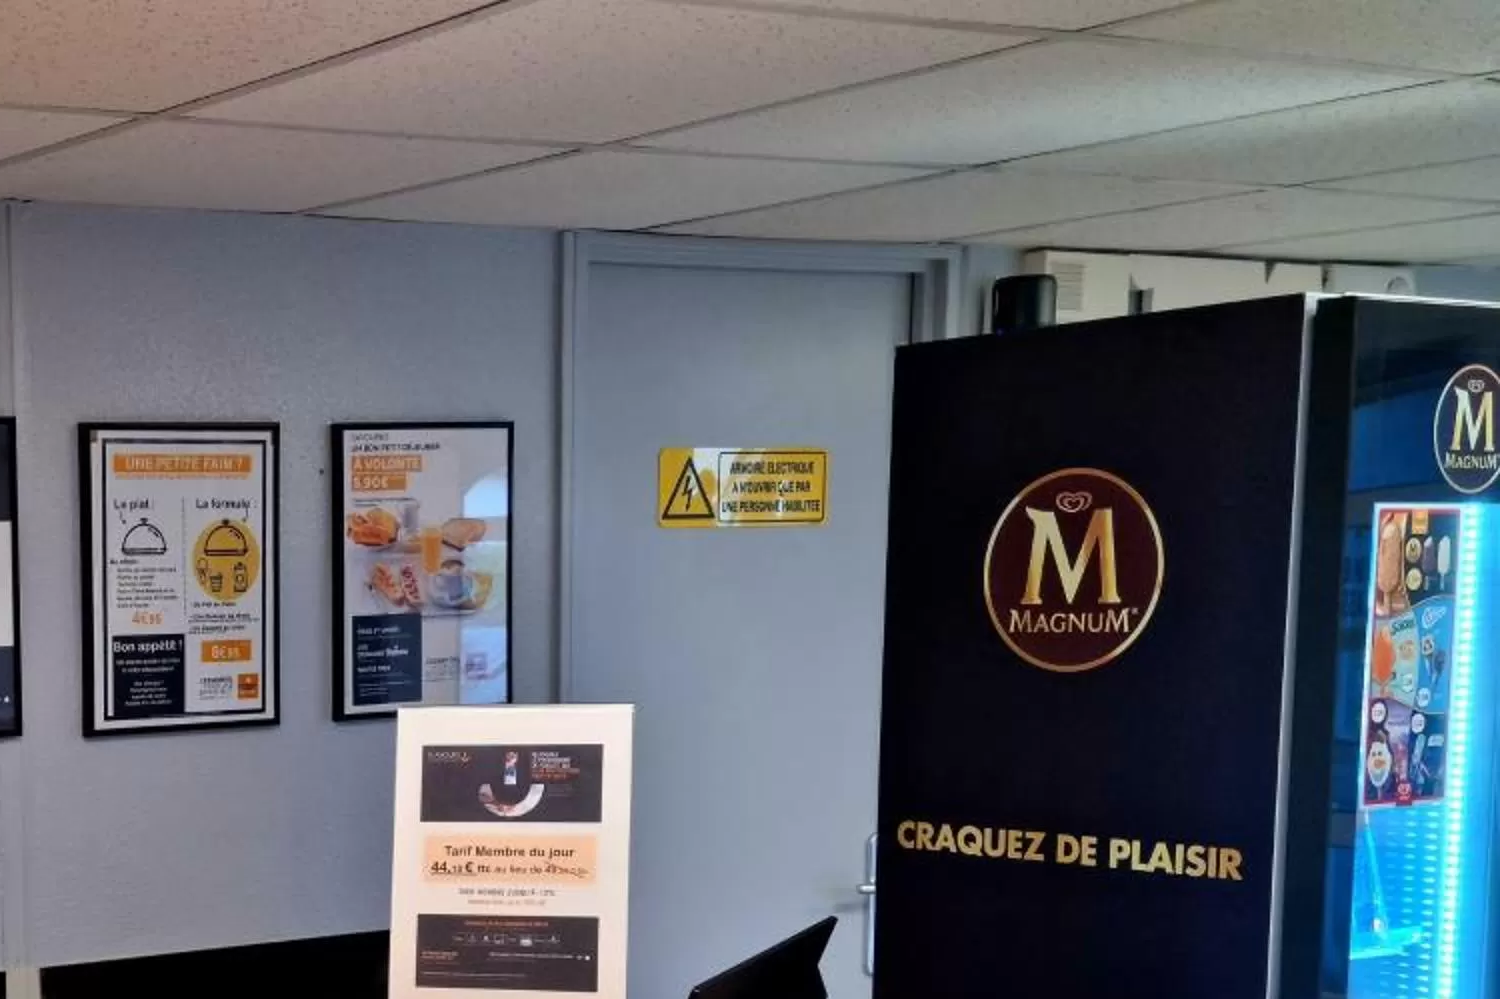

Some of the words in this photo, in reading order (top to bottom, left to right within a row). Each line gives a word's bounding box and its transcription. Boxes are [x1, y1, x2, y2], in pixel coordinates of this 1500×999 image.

[1451, 387, 1495, 451] M
[1445, 453, 1497, 471] MAGNUM
[777, 480, 795, 496] QUE
[796, 480, 810, 493] PAR
[1020, 505, 1122, 605] M
[1008, 608, 1132, 635] MAGNUM
[113, 641, 136, 652] Bon
[444, 845, 473, 857] Tarif
[475, 845, 525, 858] Membre
[529, 845, 545, 858] du
[549, 847, 575, 859] jour
[897, 820, 1045, 863] CRAQUEZ
[1056, 833, 1098, 867] DE
[1109, 839, 1244, 881] PLAISIR
